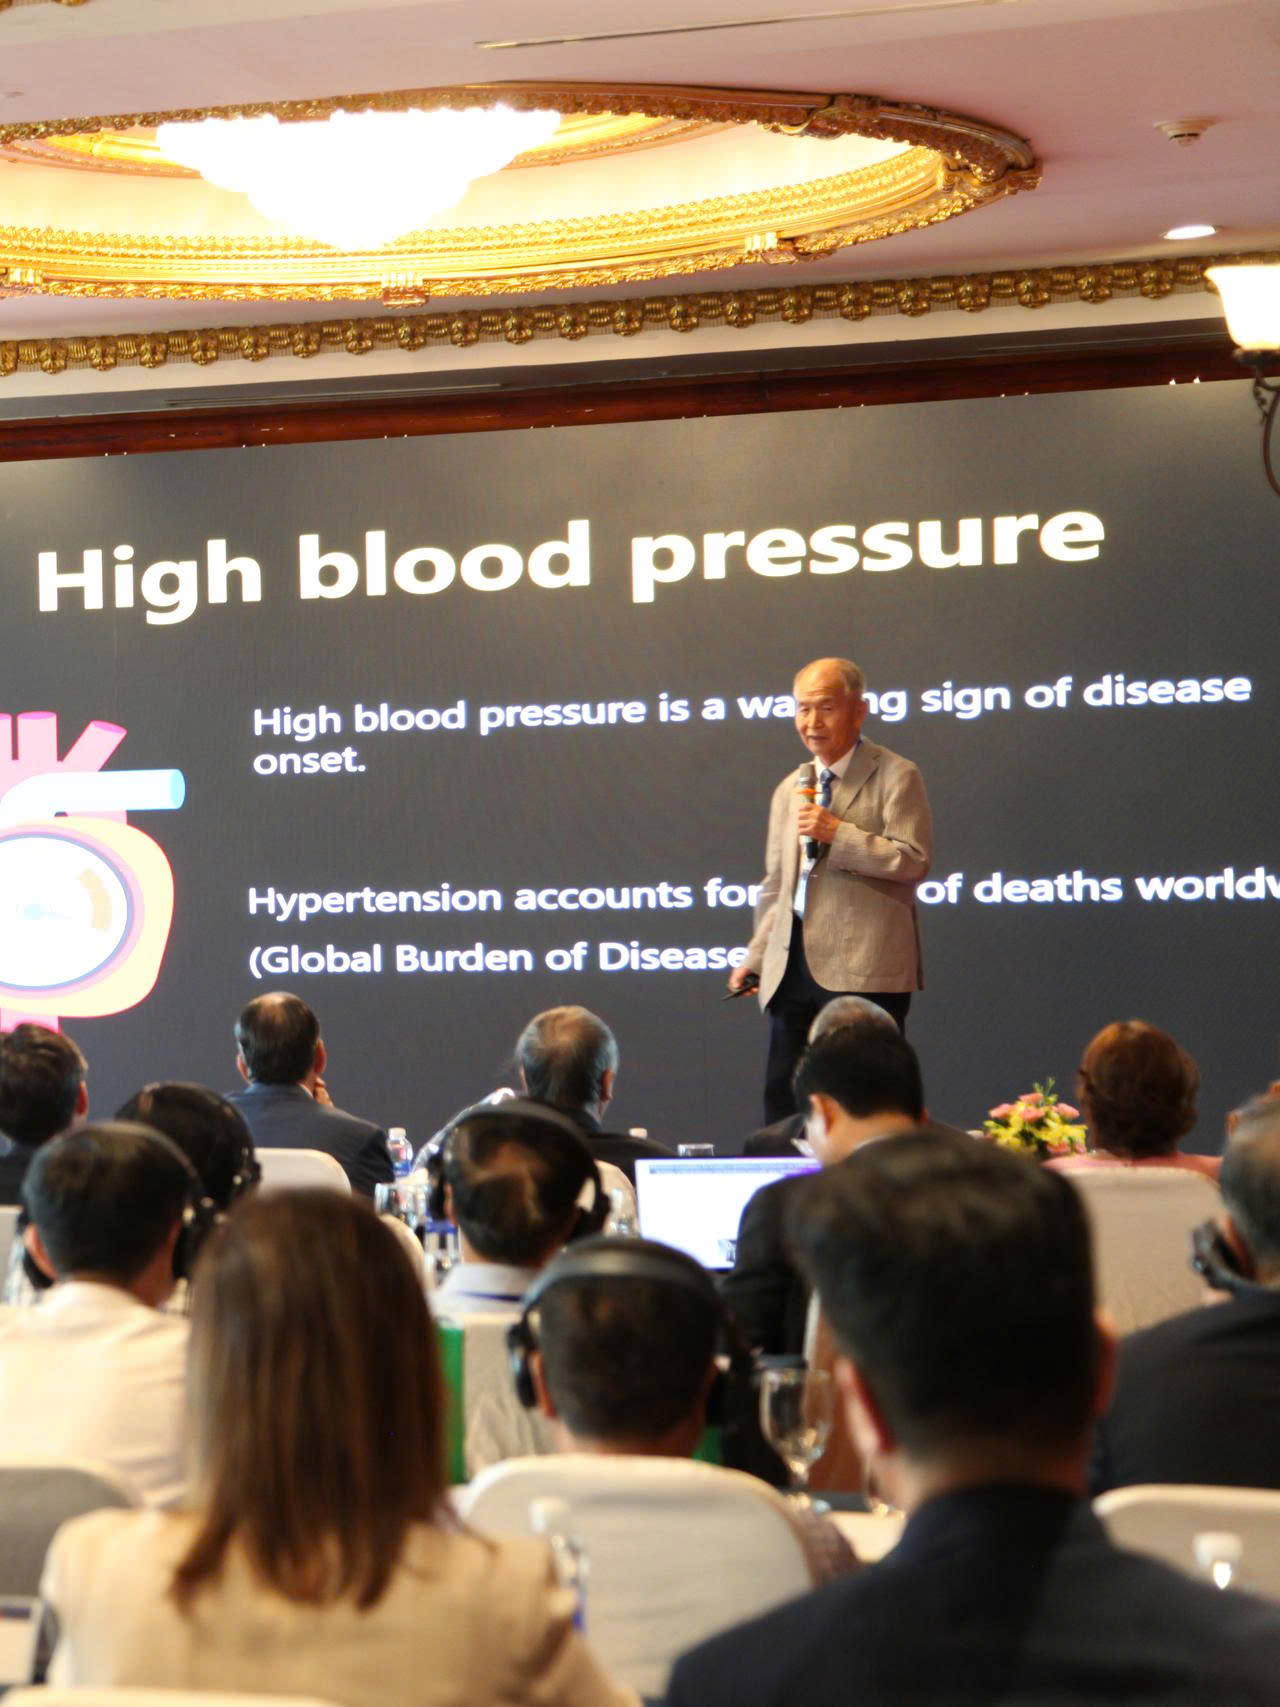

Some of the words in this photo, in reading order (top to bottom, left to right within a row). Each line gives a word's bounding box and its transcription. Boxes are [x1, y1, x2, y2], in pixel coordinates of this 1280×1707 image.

[38, 539, 262, 625] High
[299, 519, 590, 600] blood
[631, 511, 1105, 604] pressure
[253, 704, 342, 743] High
[354, 699, 467, 733] blood
[479, 701, 646, 736] pressure
[658, 692, 691, 723] is
[701, 697, 726, 721] a
[736, 690, 908, 722] wang
[920, 680, 1011, 720] sign
[1024, 675, 1073, 709] of
[1082, 673, 1252, 707] disease
[253, 746, 366, 776] onset.
[248, 885, 502, 922] Hypertension
[513, 881, 694, 911] accounts
[704, 877, 764, 908] for
[916, 872, 964, 904] of
[973, 870, 1123, 903] deaths
[249, 943, 382, 979] (Global
[395, 942, 533, 973] Burden
[544, 941, 588, 971] of
